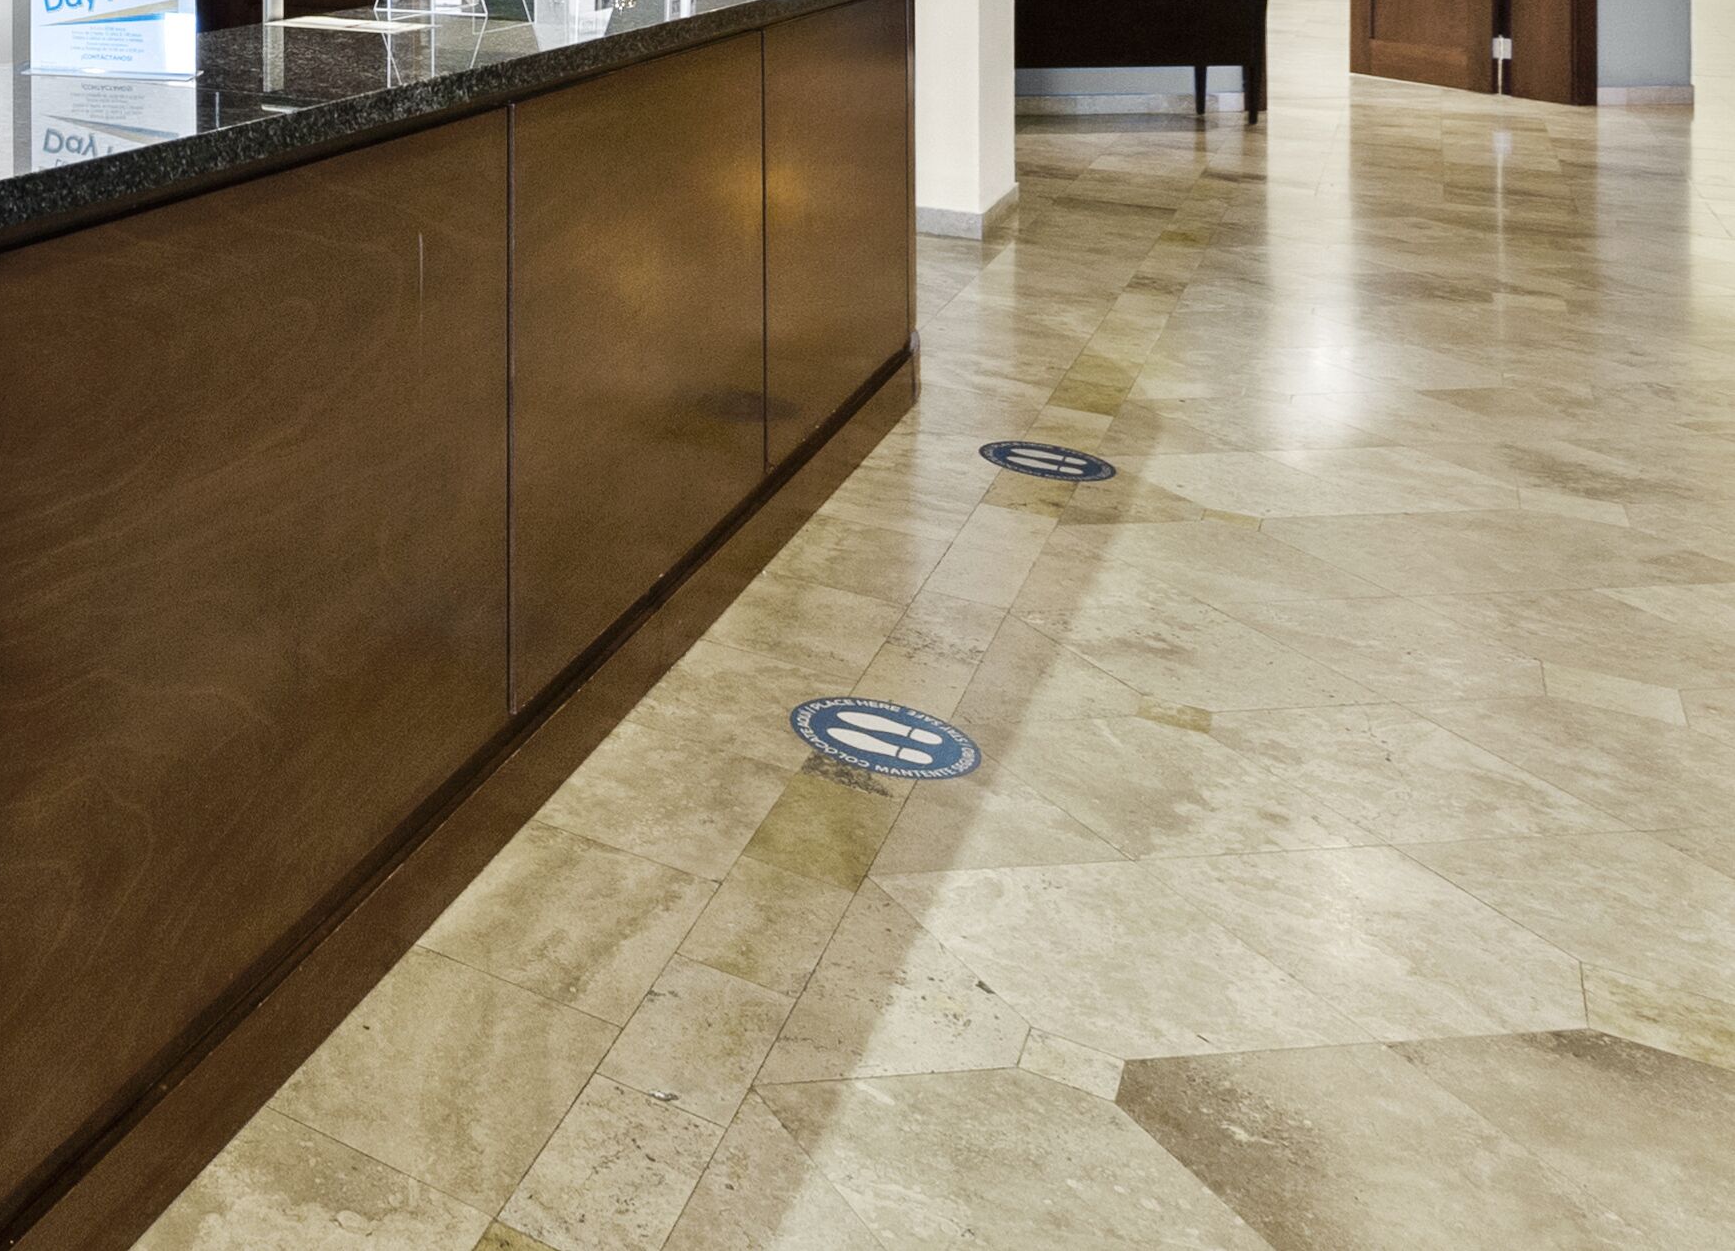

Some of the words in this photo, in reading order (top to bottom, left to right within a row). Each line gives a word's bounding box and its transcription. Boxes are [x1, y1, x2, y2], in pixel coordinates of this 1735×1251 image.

[810, 699, 857, 711] PLACE
[857, 700, 901, 712] HERE
[874, 764, 957, 779] MANTENTE
